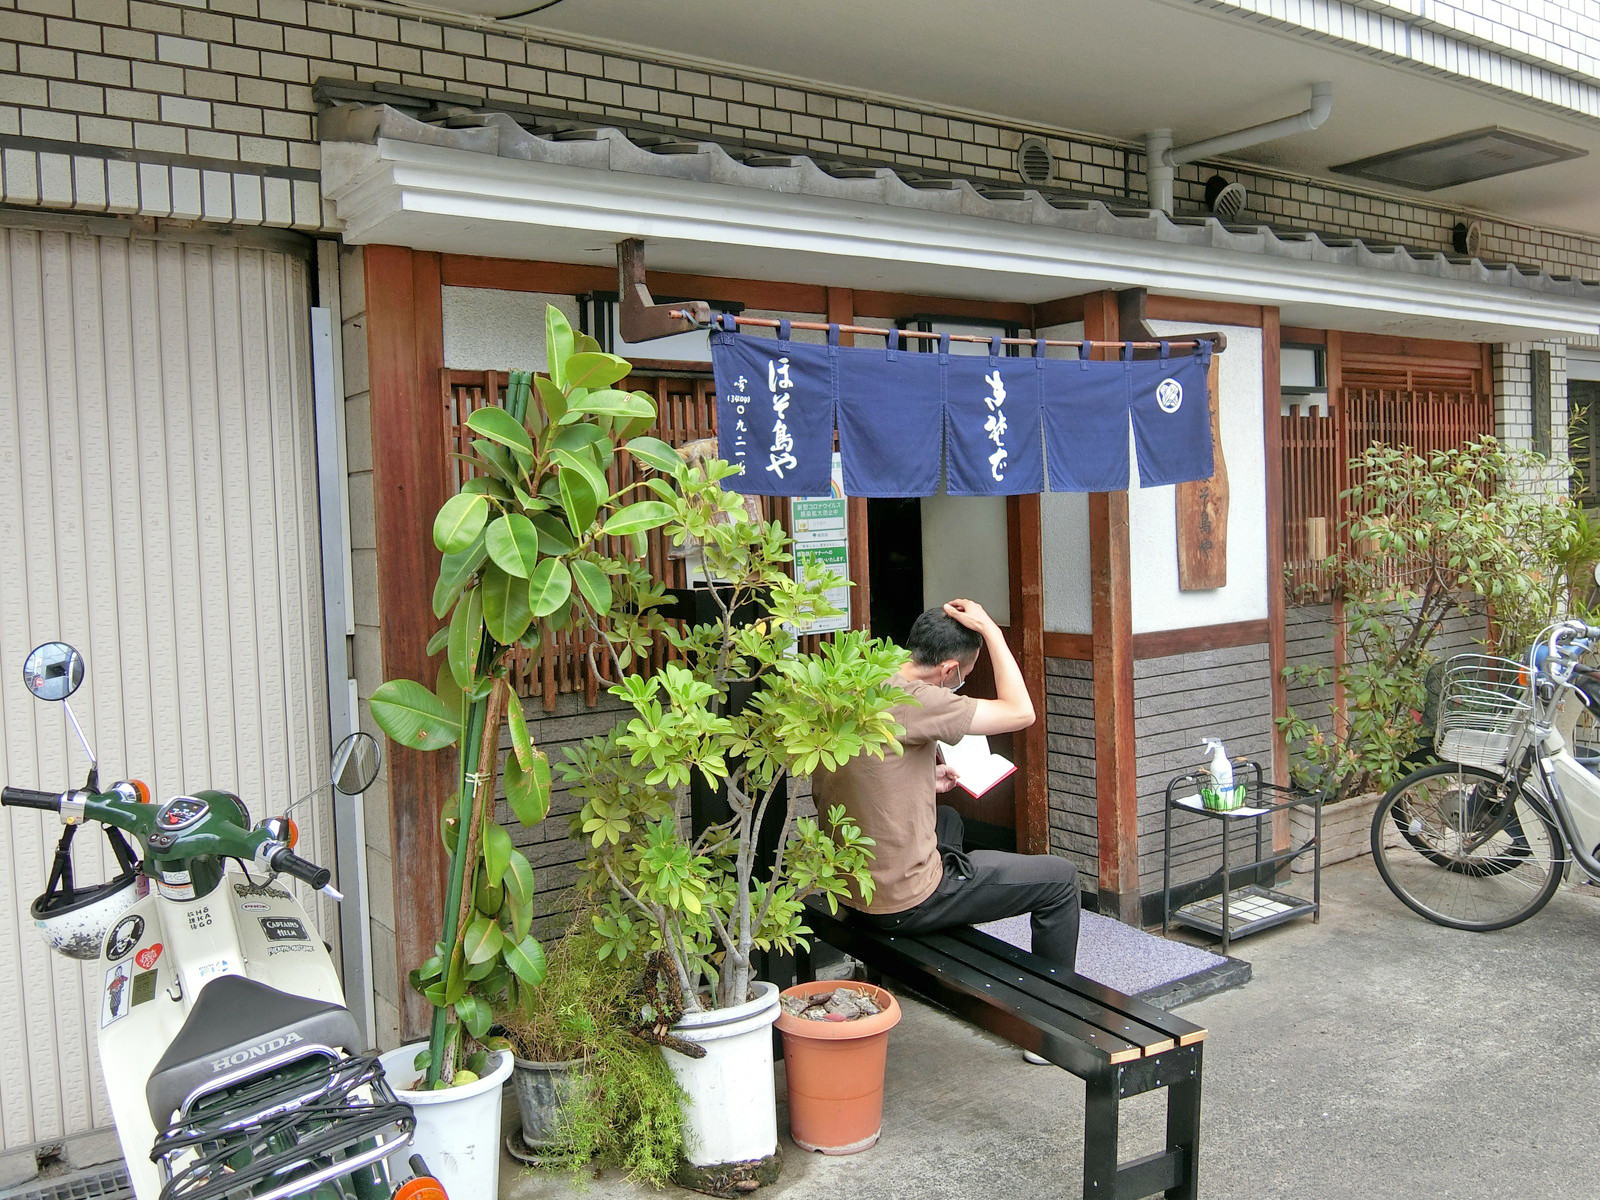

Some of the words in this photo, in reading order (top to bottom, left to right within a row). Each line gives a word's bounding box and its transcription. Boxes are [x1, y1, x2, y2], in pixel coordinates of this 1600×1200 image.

[765, 357, 798, 479] ほそ島や
[797, 502, 841, 511] 新型コロナウイルス
[800, 509, 839, 517] 感染拡大防止中
[1198, 477, 1214, 558] そ島や
[211, 1032, 304, 1073] HONDA
